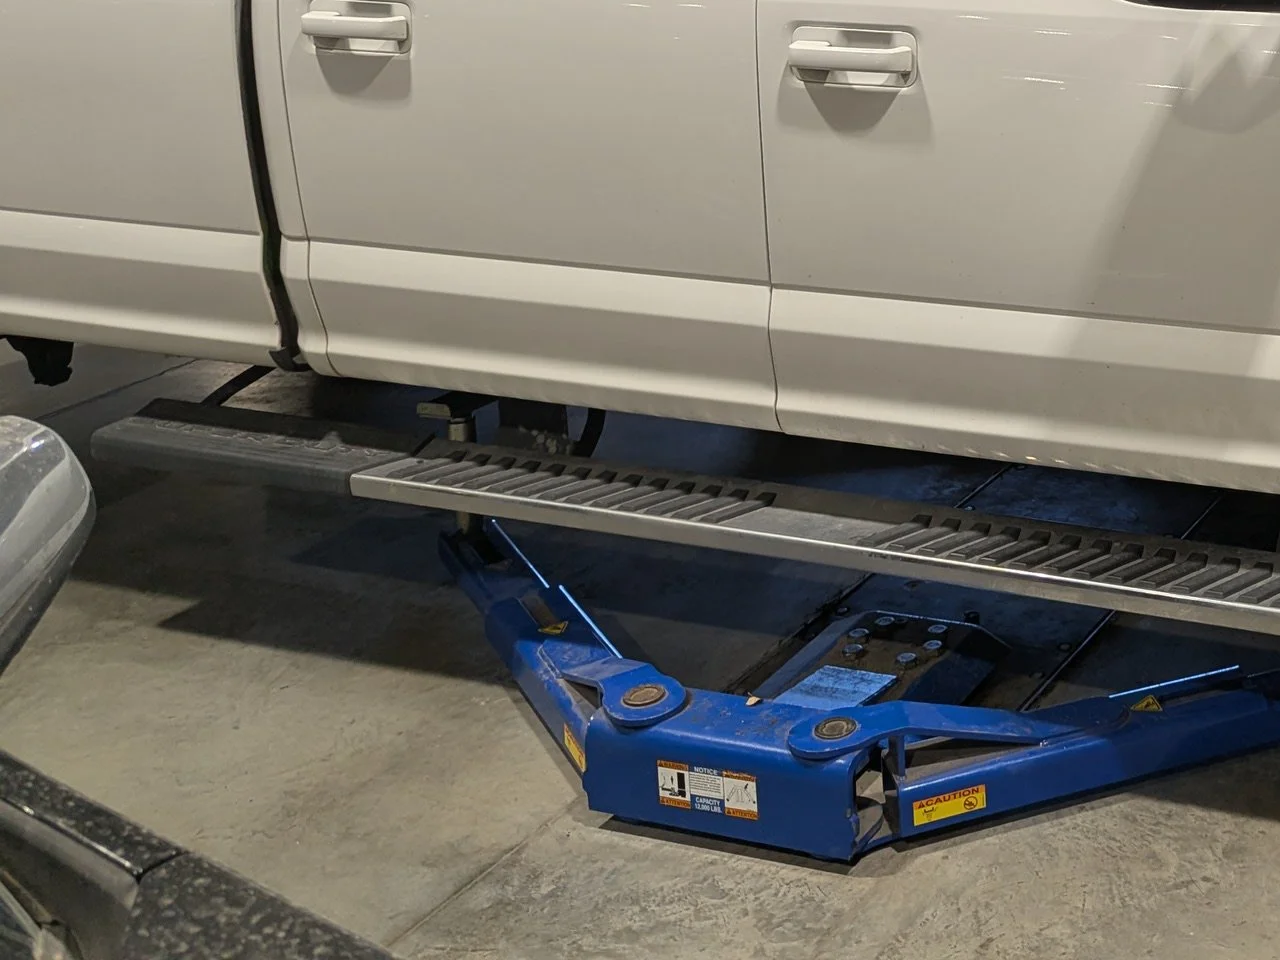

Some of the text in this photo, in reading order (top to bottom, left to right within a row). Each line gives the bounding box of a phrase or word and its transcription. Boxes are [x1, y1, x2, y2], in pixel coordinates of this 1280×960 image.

[694, 766, 719, 776] NOTICE
[695, 796, 721, 807] CAPACITY
[925, 787, 979, 807] CAUTION
